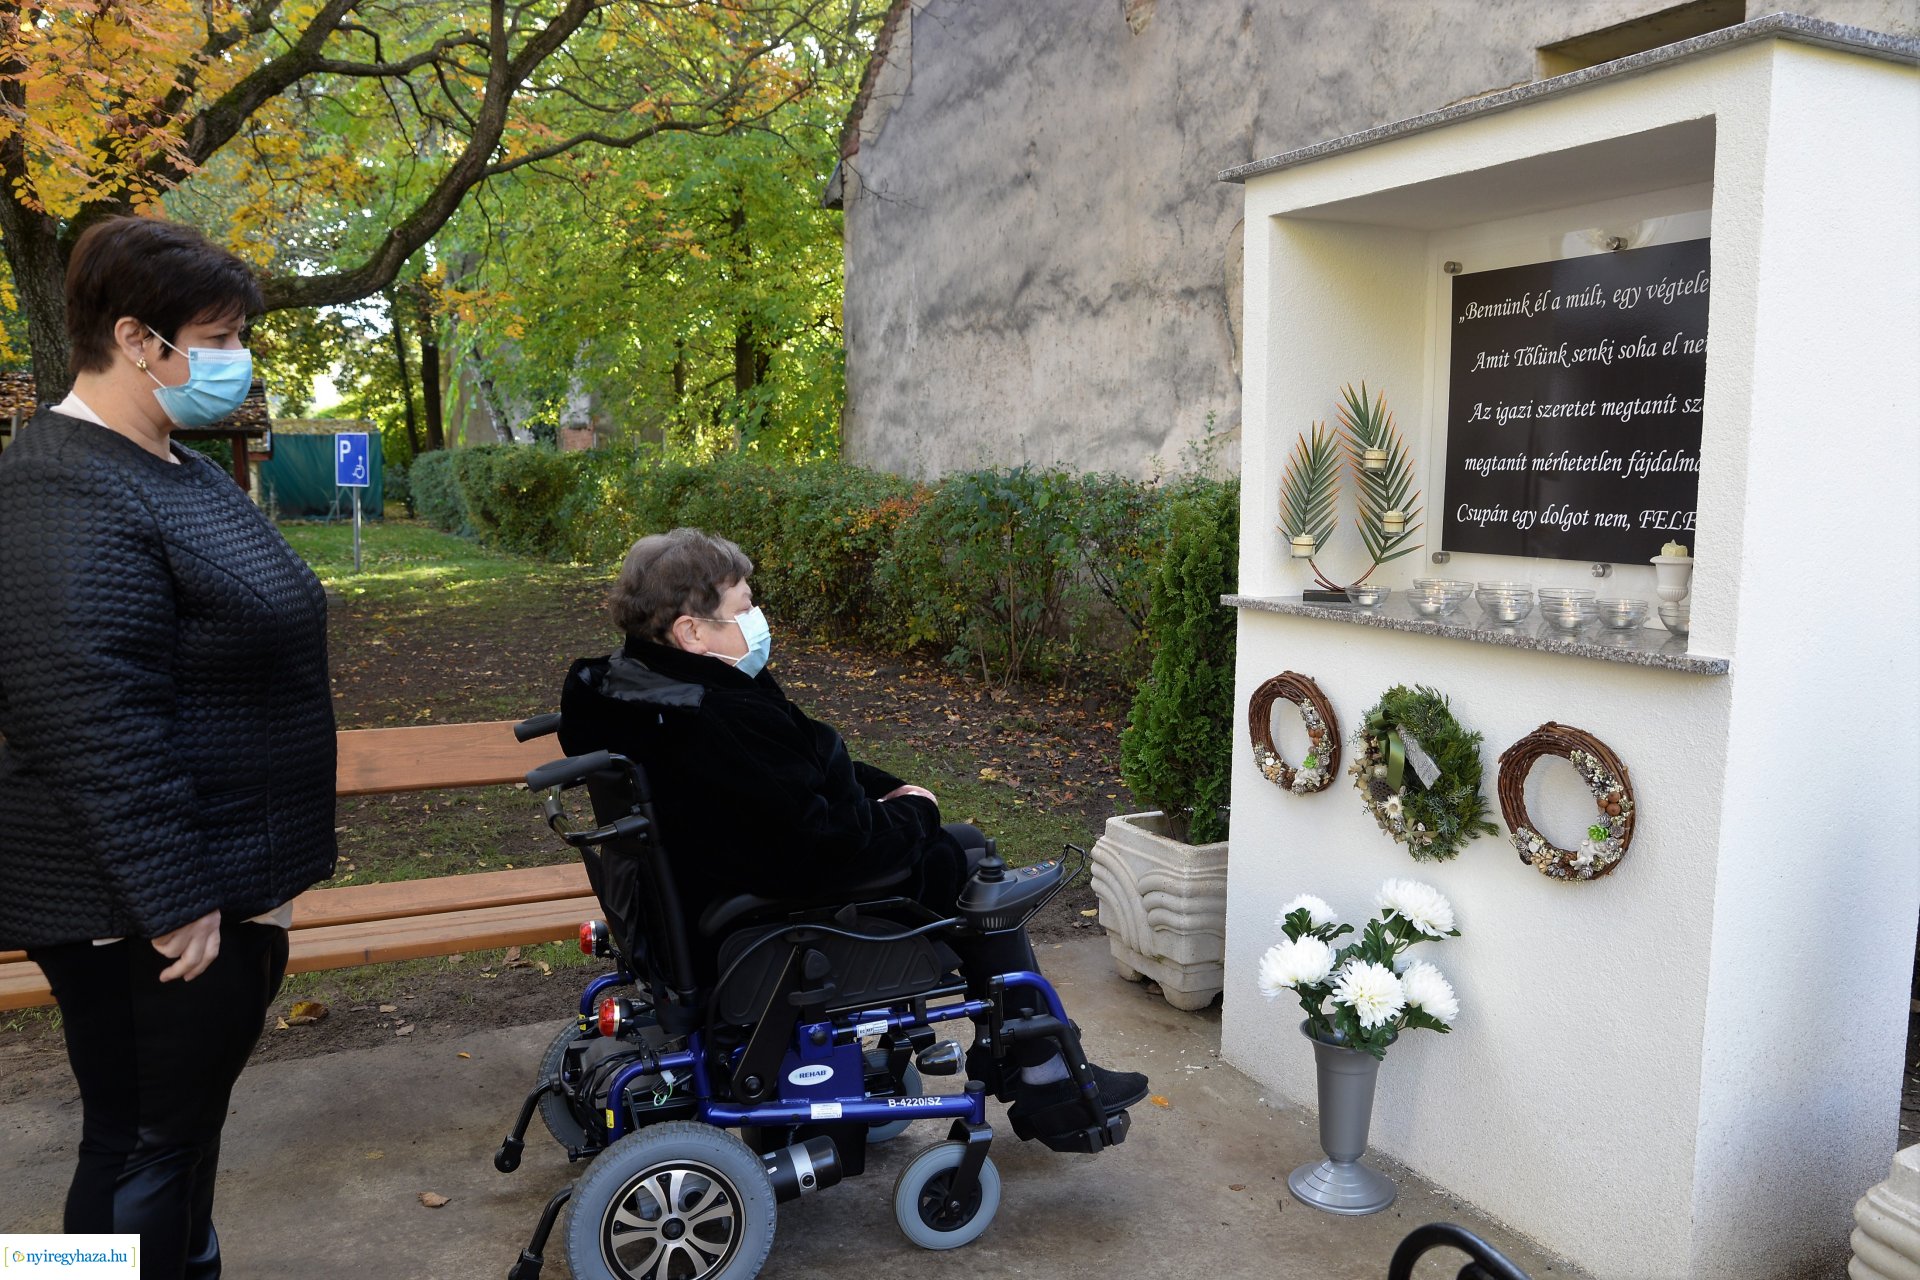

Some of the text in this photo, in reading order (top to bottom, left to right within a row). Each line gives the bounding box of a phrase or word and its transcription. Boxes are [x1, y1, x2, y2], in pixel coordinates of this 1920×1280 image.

[1459, 292, 1533, 323] „Bennünk
[1534, 290, 1551, 311] él
[1551, 296, 1561, 310] a
[1566, 284, 1606, 308] múlt,
[1613, 284, 1642, 309] egy
[1471, 332, 1708, 372] Amit Tőlünk senki soha el ne
[1468, 402, 1492, 423] Az
[1495, 400, 1532, 426] igazi
[1535, 399, 1596, 419] szeretet
[1601, 393, 1678, 422] megtanít
[340, 440, 351, 463] P
[1464, 453, 1528, 477] megtanít
[1531, 450, 1622, 473] mérhetetlen
[1456, 503, 1697, 532] Csupán egy dolgot nem, FELE
[799, 1070, 826, 1079] REHAB
